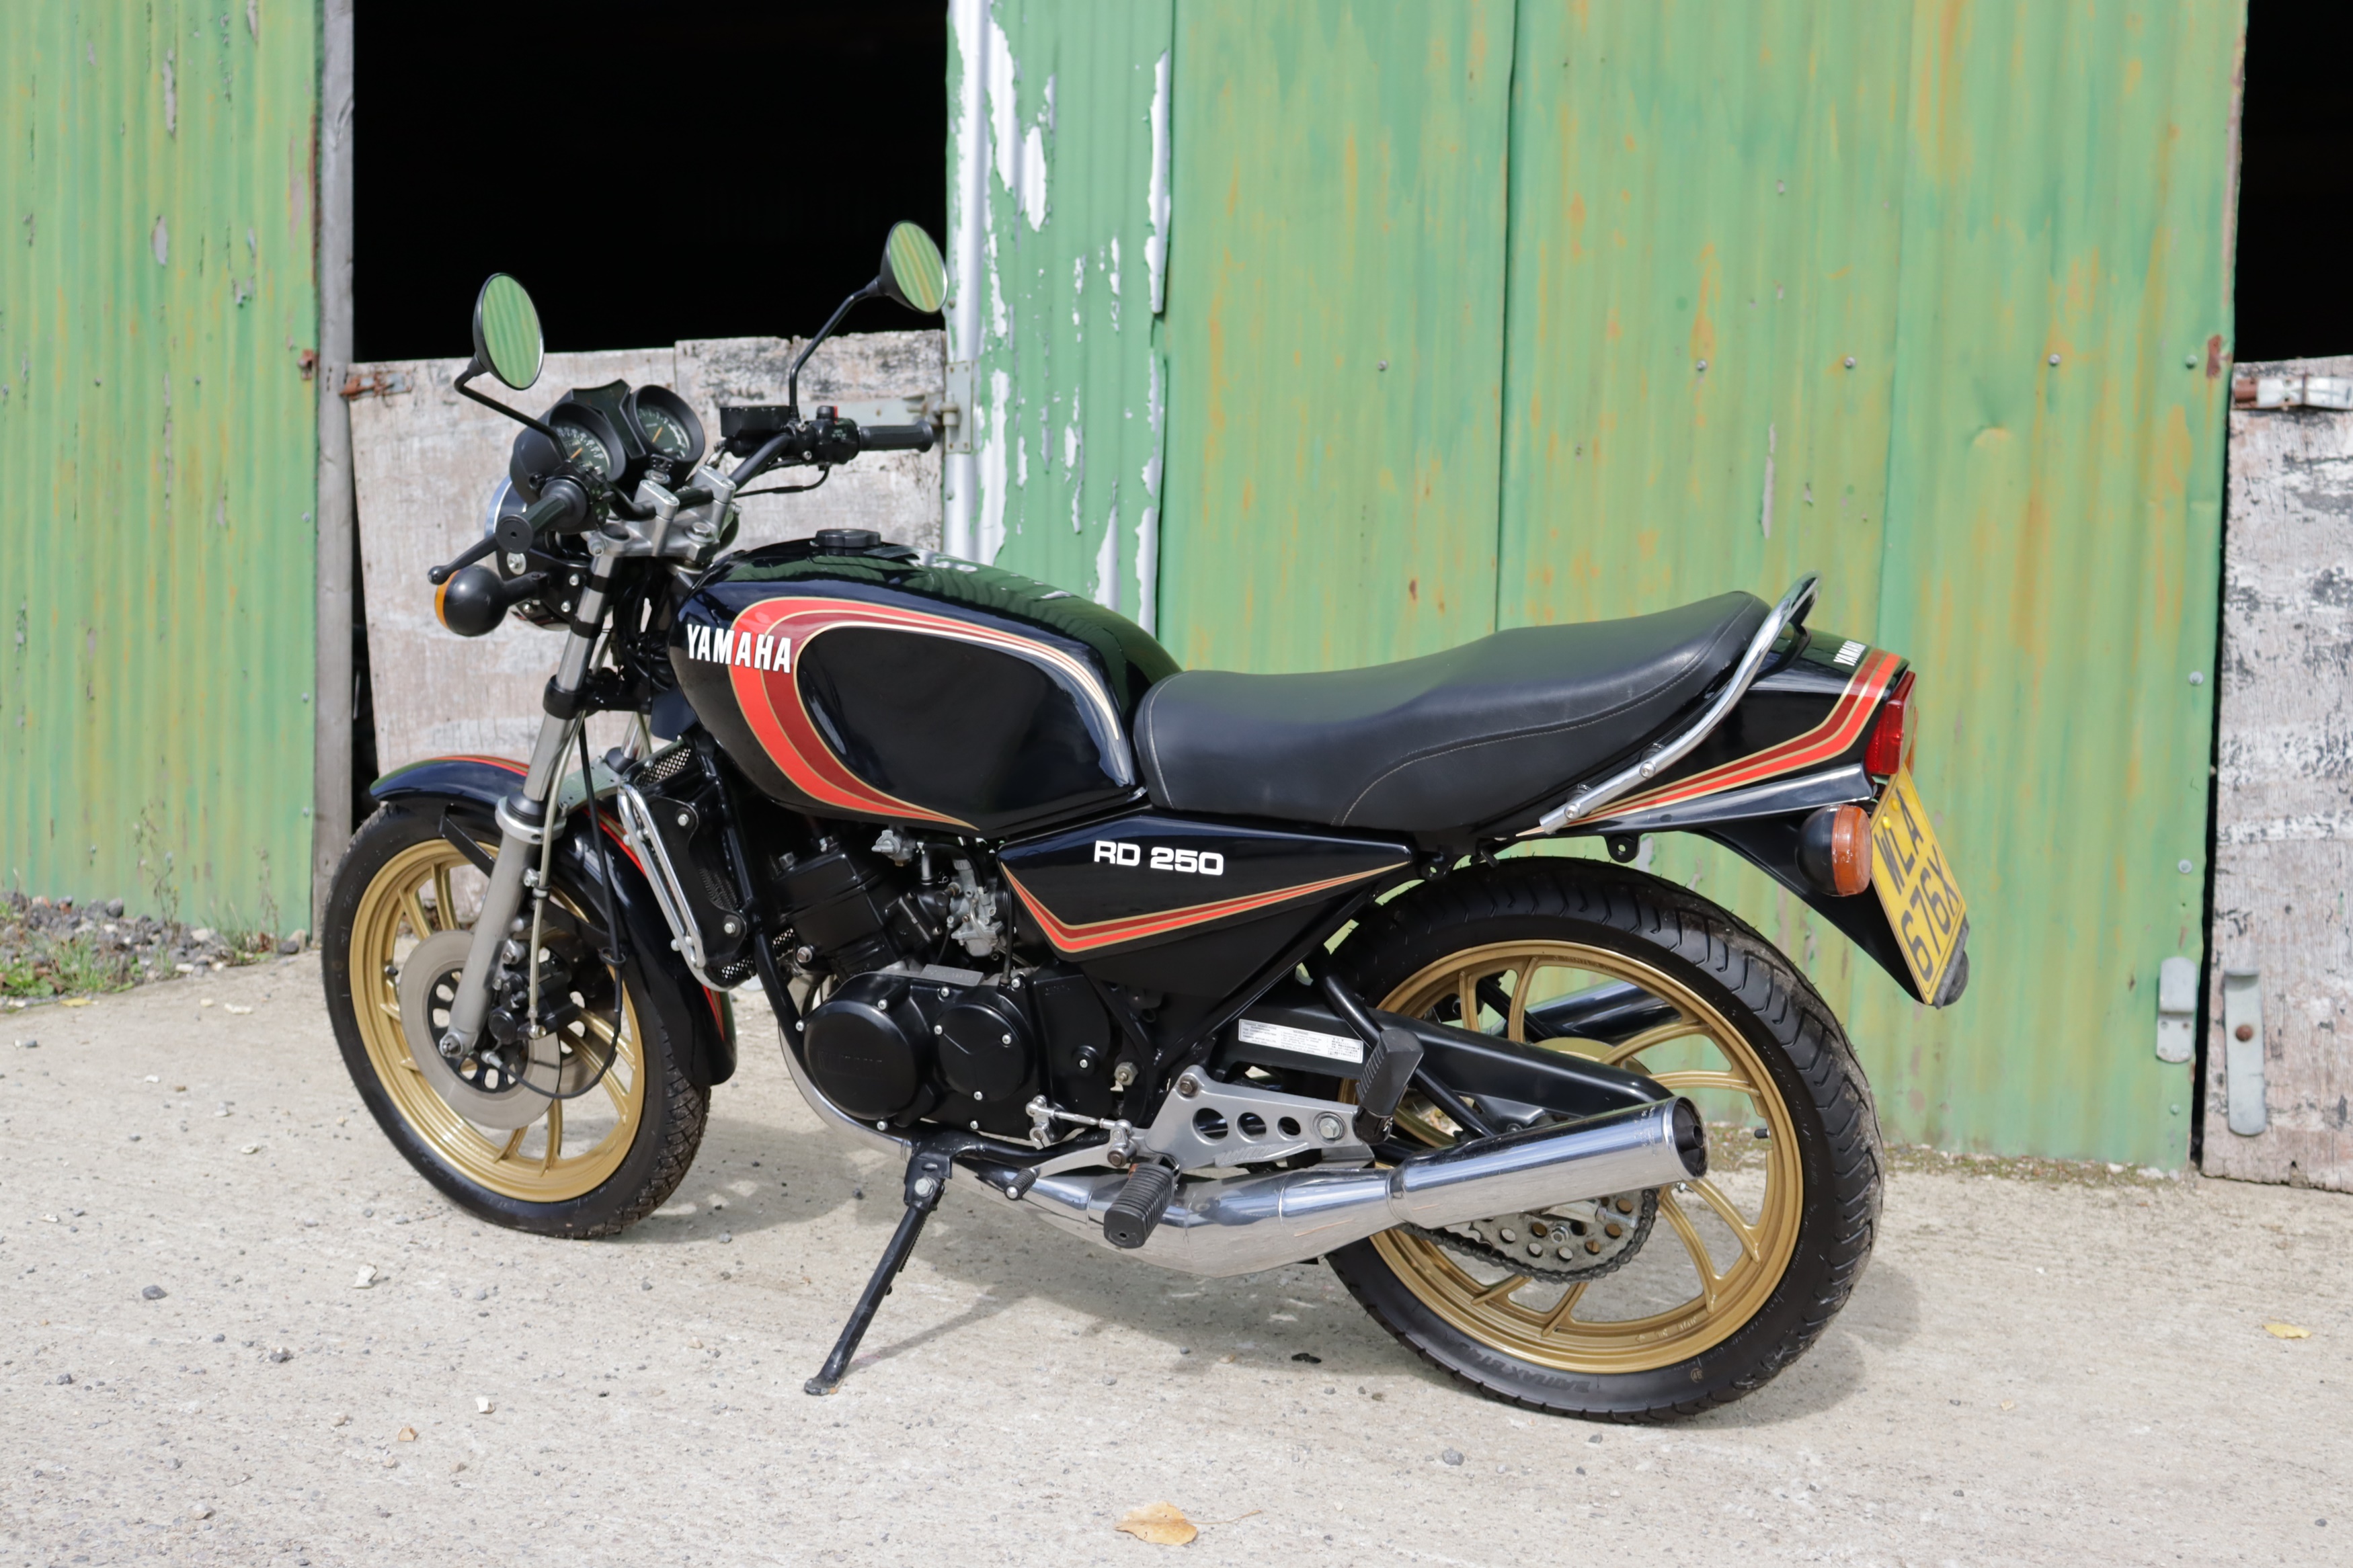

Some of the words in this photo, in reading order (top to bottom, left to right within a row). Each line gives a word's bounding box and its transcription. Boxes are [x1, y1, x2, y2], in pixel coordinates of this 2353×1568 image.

[687, 624, 791, 673] YAMAHA
[1833, 640, 1866, 666] YAMAHA
[1094, 840, 1140, 866] RD
[1150, 847, 1224, 875] 250
[1874, 788, 1923, 895] WLA
[1901, 844, 1959, 982] 676X
